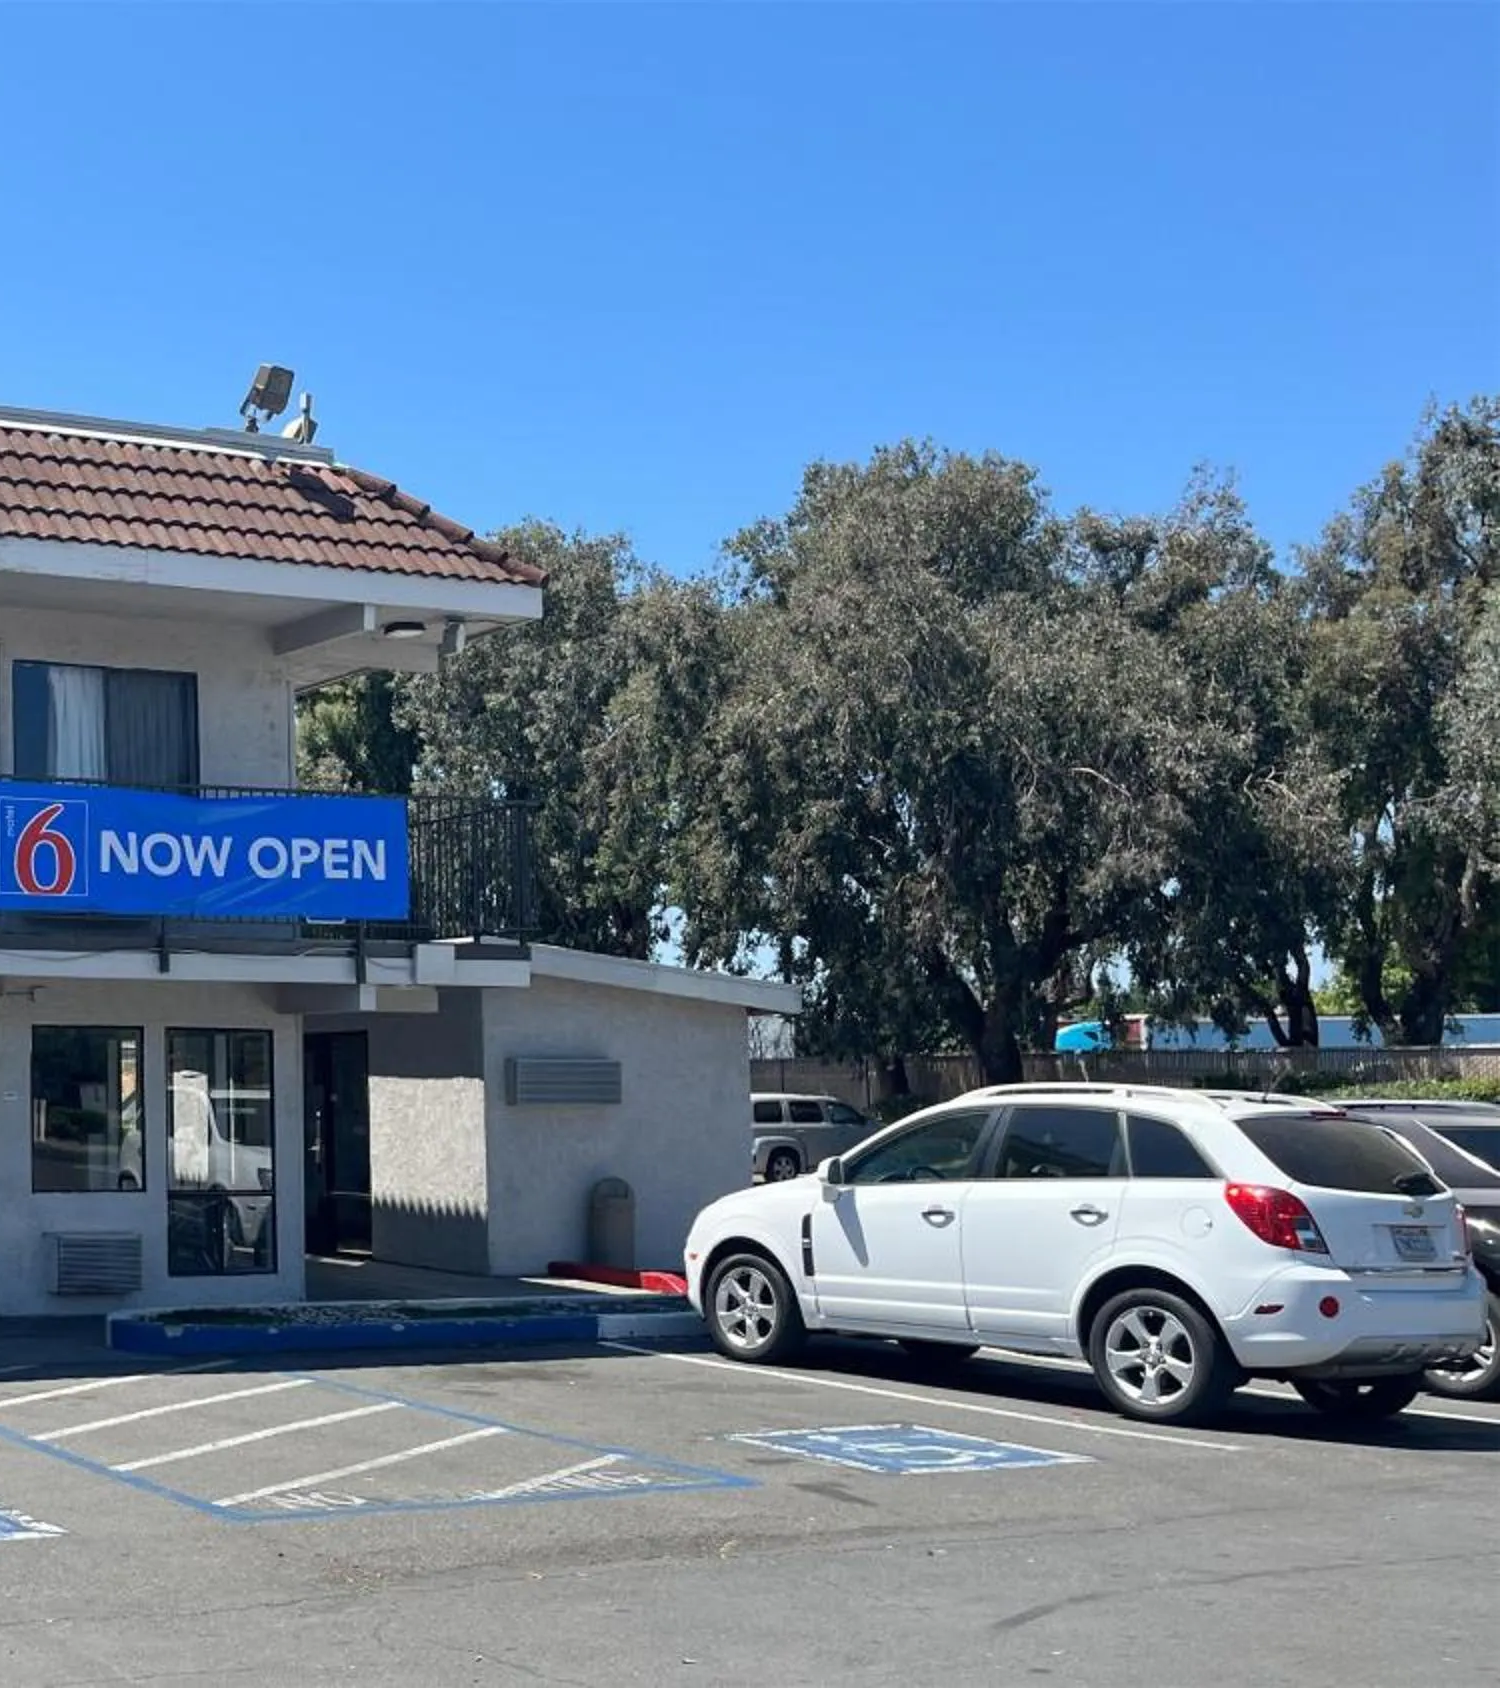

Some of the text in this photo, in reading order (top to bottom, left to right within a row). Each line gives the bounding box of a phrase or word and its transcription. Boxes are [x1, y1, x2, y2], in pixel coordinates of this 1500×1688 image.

[14, 803, 77, 896] 6
[99, 830, 387, 882] NOW OPEN
